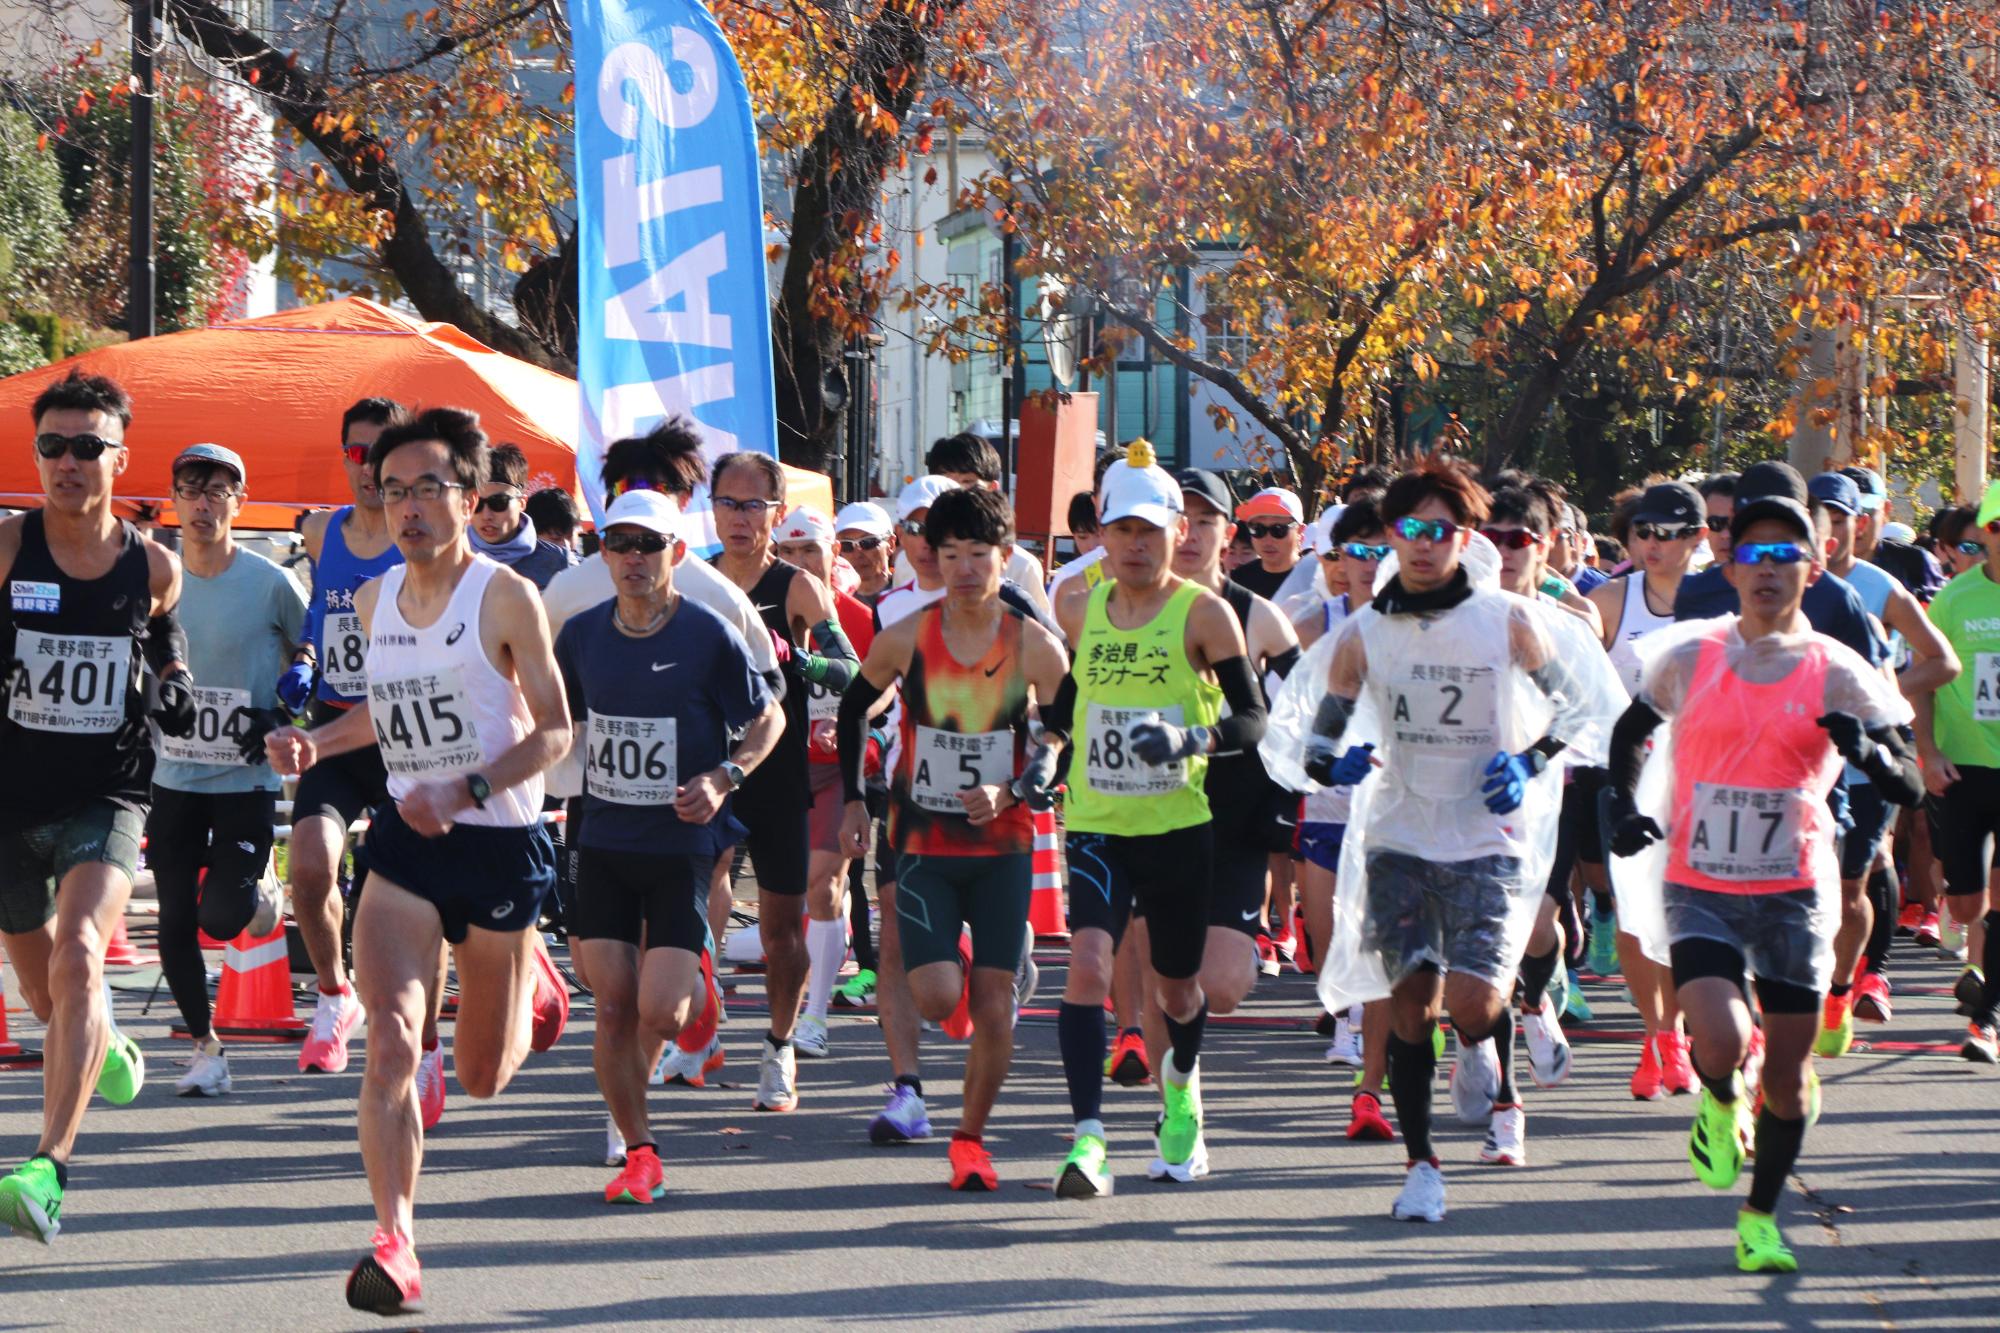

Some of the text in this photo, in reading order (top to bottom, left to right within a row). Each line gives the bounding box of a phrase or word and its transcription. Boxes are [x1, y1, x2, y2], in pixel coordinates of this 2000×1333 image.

[13, 598, 59, 612] 長野電子
[37, 637, 113, 659] 長野電子
[326, 634, 369, 674] A8
[1089, 643, 1138, 665] 多治見
[13, 660, 117, 706] A401
[1086, 665, 1171, 687] ランナーズ
[1411, 664, 1486, 683] 長野電子
[371, 675, 440, 702] 長野電子
[375, 694, 463, 750] A415
[594, 717, 657, 738] 長野電子
[933, 733, 997, 752] 長野電子
[588, 738, 667, 780] A406
[1712, 789, 1785, 809] 長野電子
